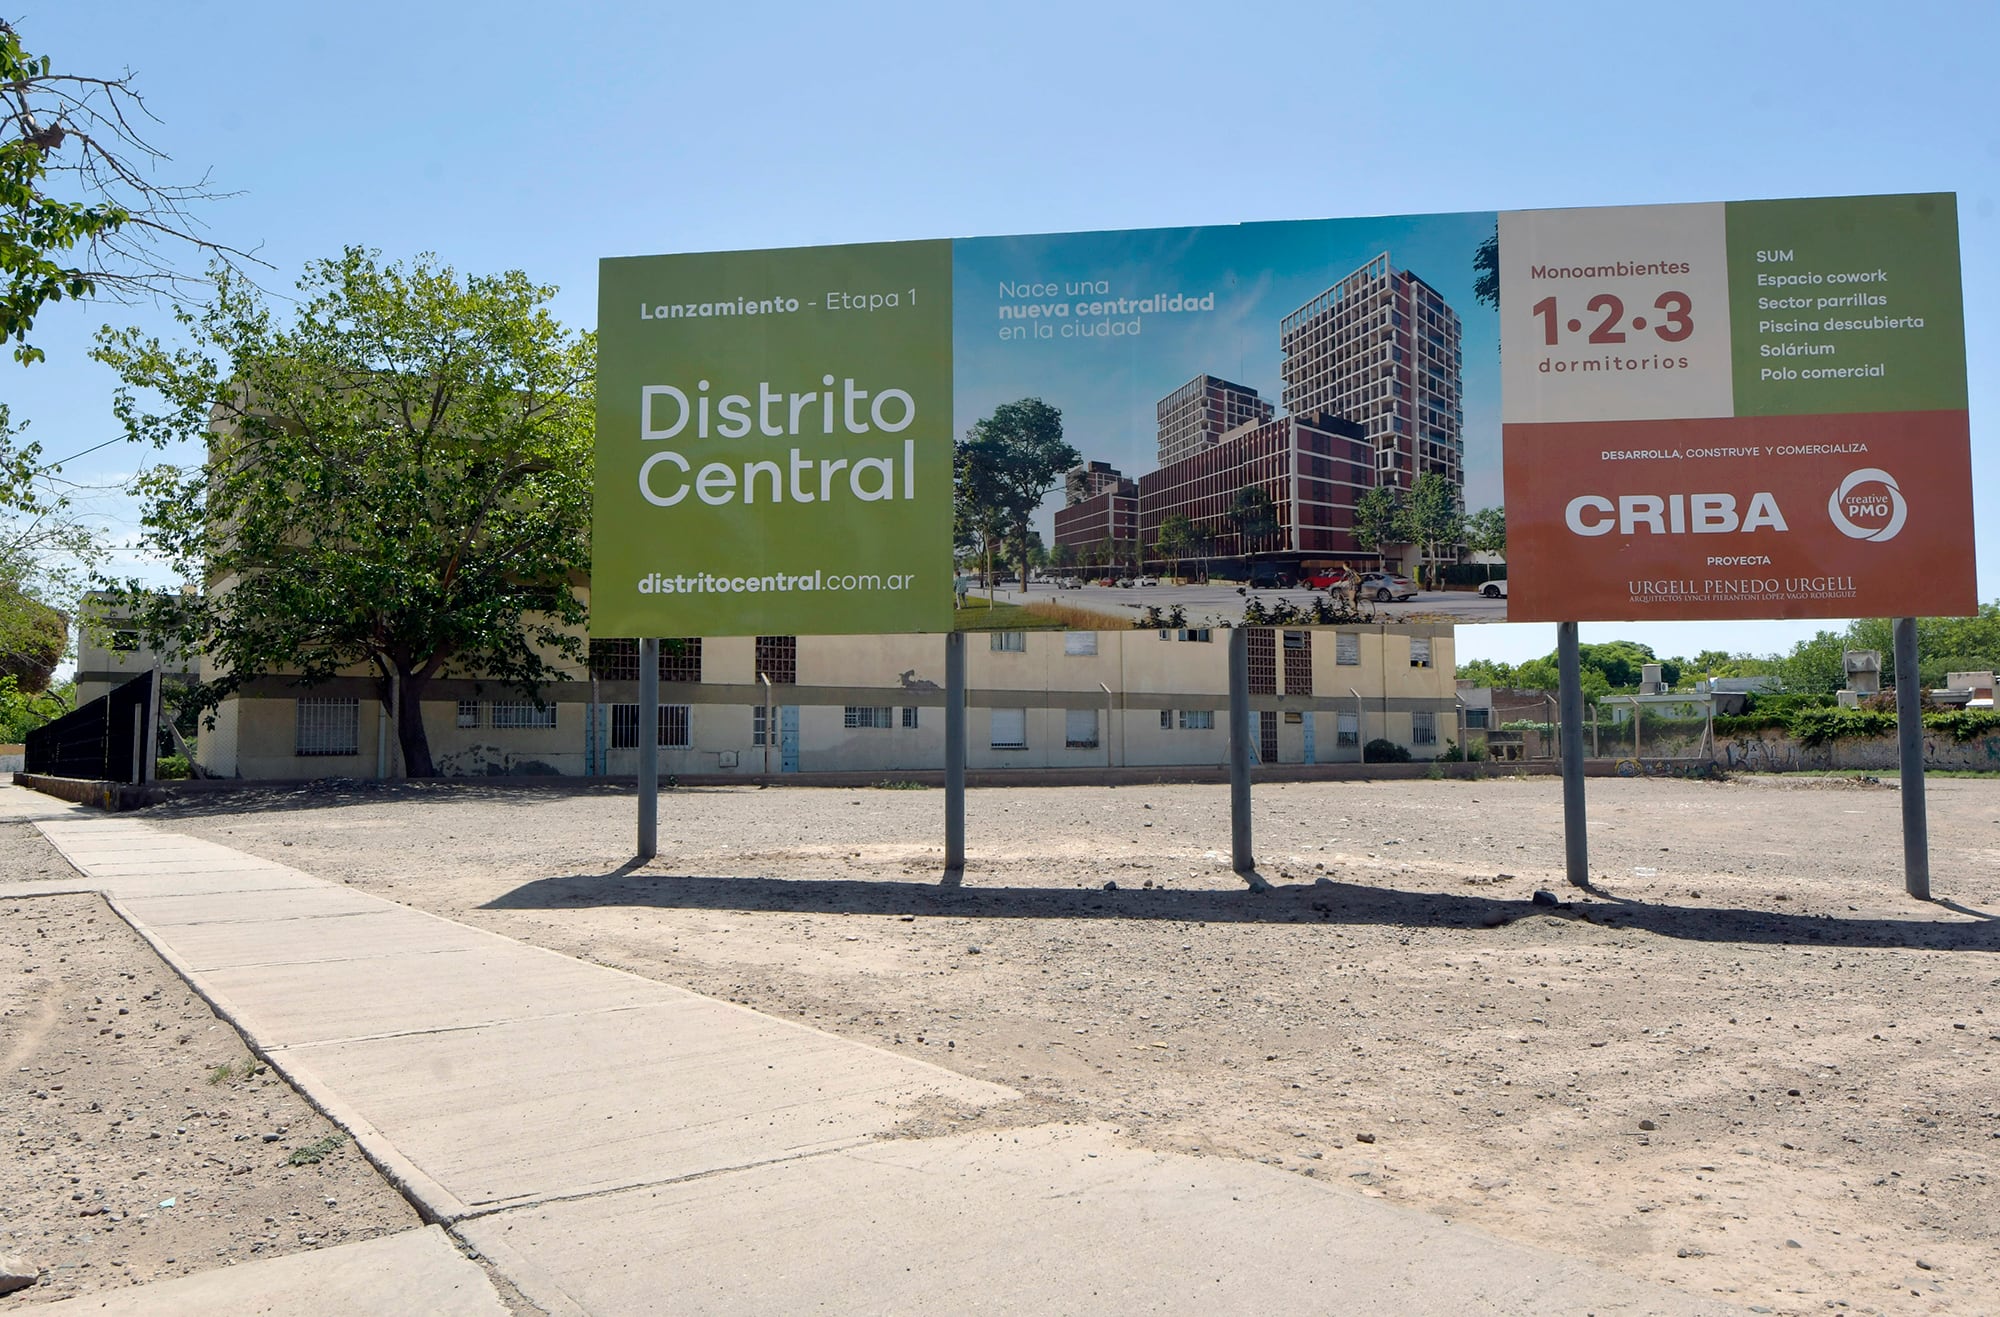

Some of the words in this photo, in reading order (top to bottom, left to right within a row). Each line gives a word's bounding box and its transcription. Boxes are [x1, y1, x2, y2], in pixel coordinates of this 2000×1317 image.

[1756, 250, 1794, 263] SUM
[1531, 259, 1690, 280] Monoambientes
[1757, 271, 1823, 288] Espacio
[1826, 269, 1888, 284] cowork
[999, 281, 1058, 299] Nace
[1066, 280, 1109, 296] una
[641, 296, 799, 320] Lanzamiento
[827, 291, 899, 312] Etapa
[907, 288, 917, 306] 1
[999, 302, 1070, 320] nueva
[1075, 292, 1215, 316] centralidad
[1758, 296, 1813, 310] Sector
[1817, 293, 1887, 310] parrillas
[998, 325, 1026, 341] en
[1034, 321, 1053, 338] la
[1060, 316, 1141, 337] ciudad
[1759, 319, 1819, 333] Piscina
[1823, 315, 1924, 331] descubierta
[1760, 342, 1835, 357] Solárium
[1538, 353, 1689, 373] dormitorios
[1761, 367, 1797, 381] Polo
[1801, 363, 1885, 379] comercial
[641, 374, 916, 441] Distrito
[1601, 449, 1683, 460] DESARROLLA,
[1686, 446, 1760, 459] CONSTRUYE
[1764, 446, 1773, 456] Y
[1776, 443, 1868, 456] COMERCIALIZA
[638, 439, 915, 507] Central
[1846, 493, 1888, 504] creative
[1565, 492, 1789, 537] CRIBA
[1849, 504, 1889, 517] PMO
[1707, 556, 1771, 566] PROYECTA
[638, 569, 915, 594] distritocentral.com.ar
[1629, 580, 1698, 595] URGELL
[1704, 578, 1779, 594] PENEDO
[1785, 576, 1856, 592] URGELL
[1629, 594, 1682, 603] ARQUITECTOS
[1810, 591, 1856, 599] RODRIGUEZ
